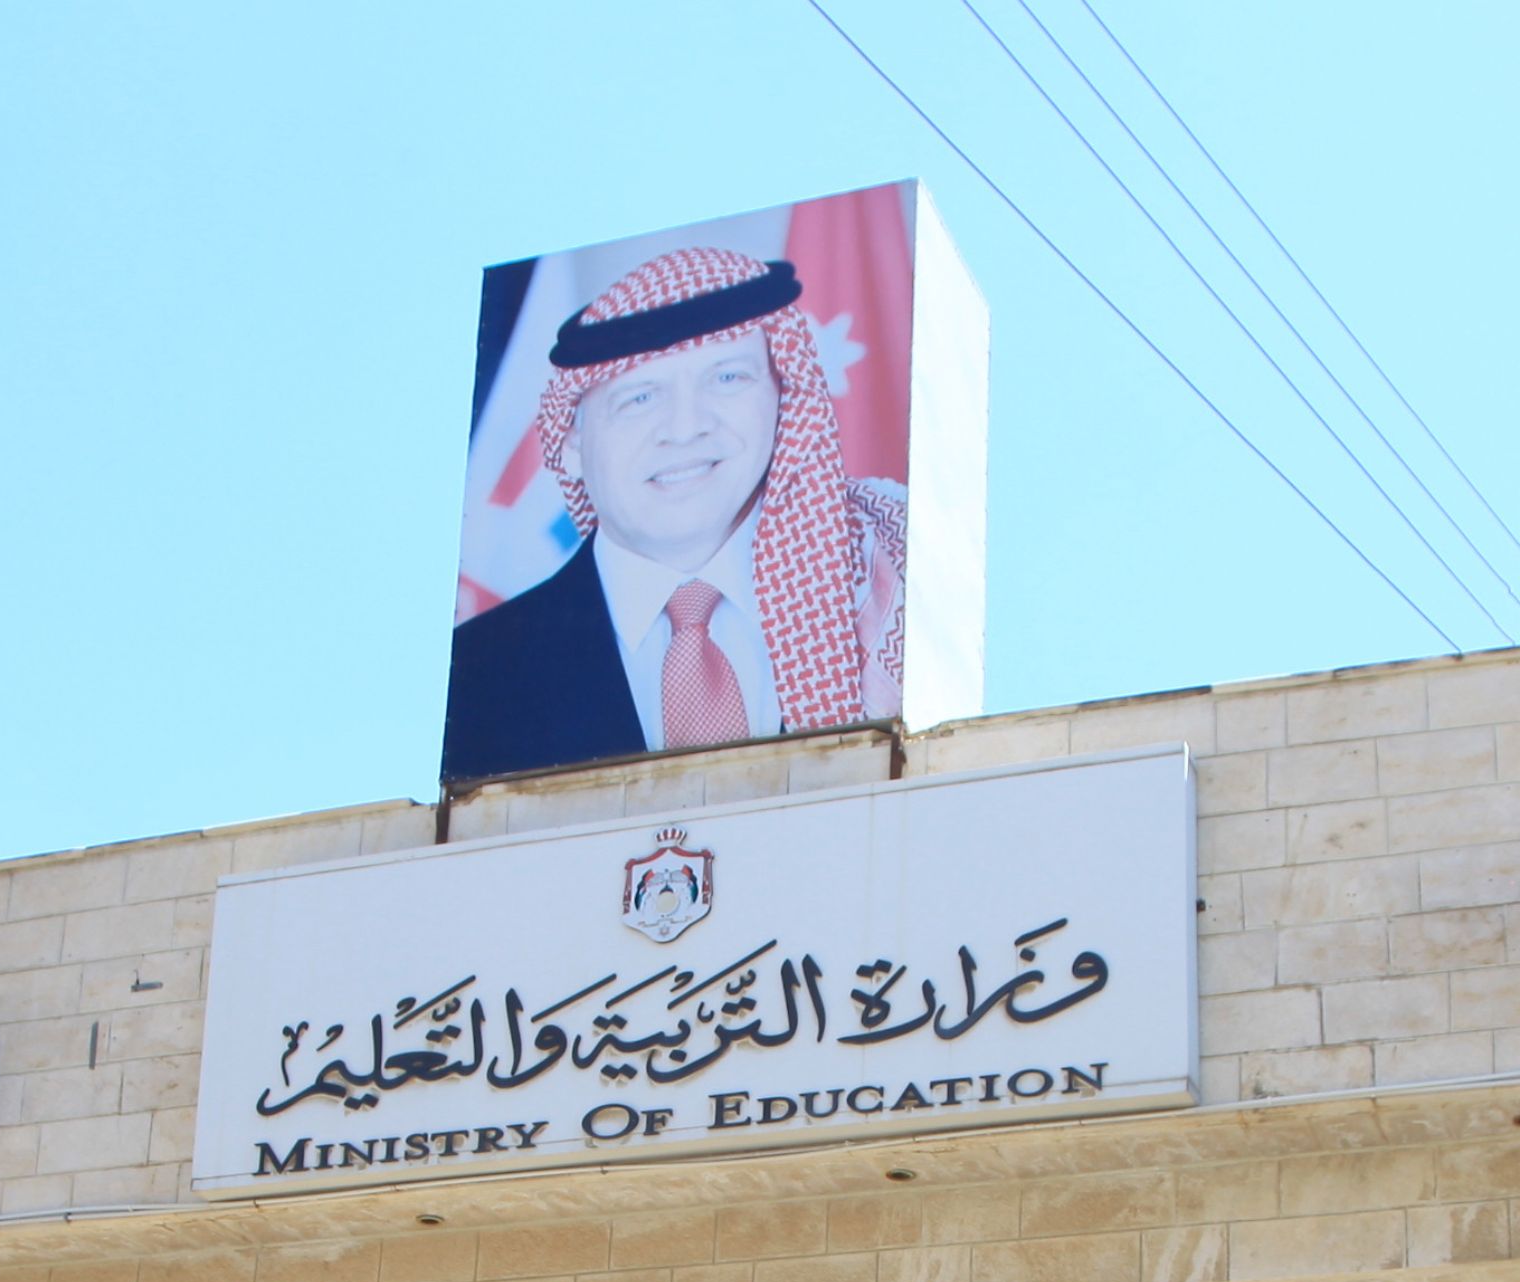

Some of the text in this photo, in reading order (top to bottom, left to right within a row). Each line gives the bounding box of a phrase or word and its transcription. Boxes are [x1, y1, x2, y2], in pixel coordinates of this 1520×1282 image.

[251, 1062, 1110, 1178] MINISTRY OF EDUCATION
